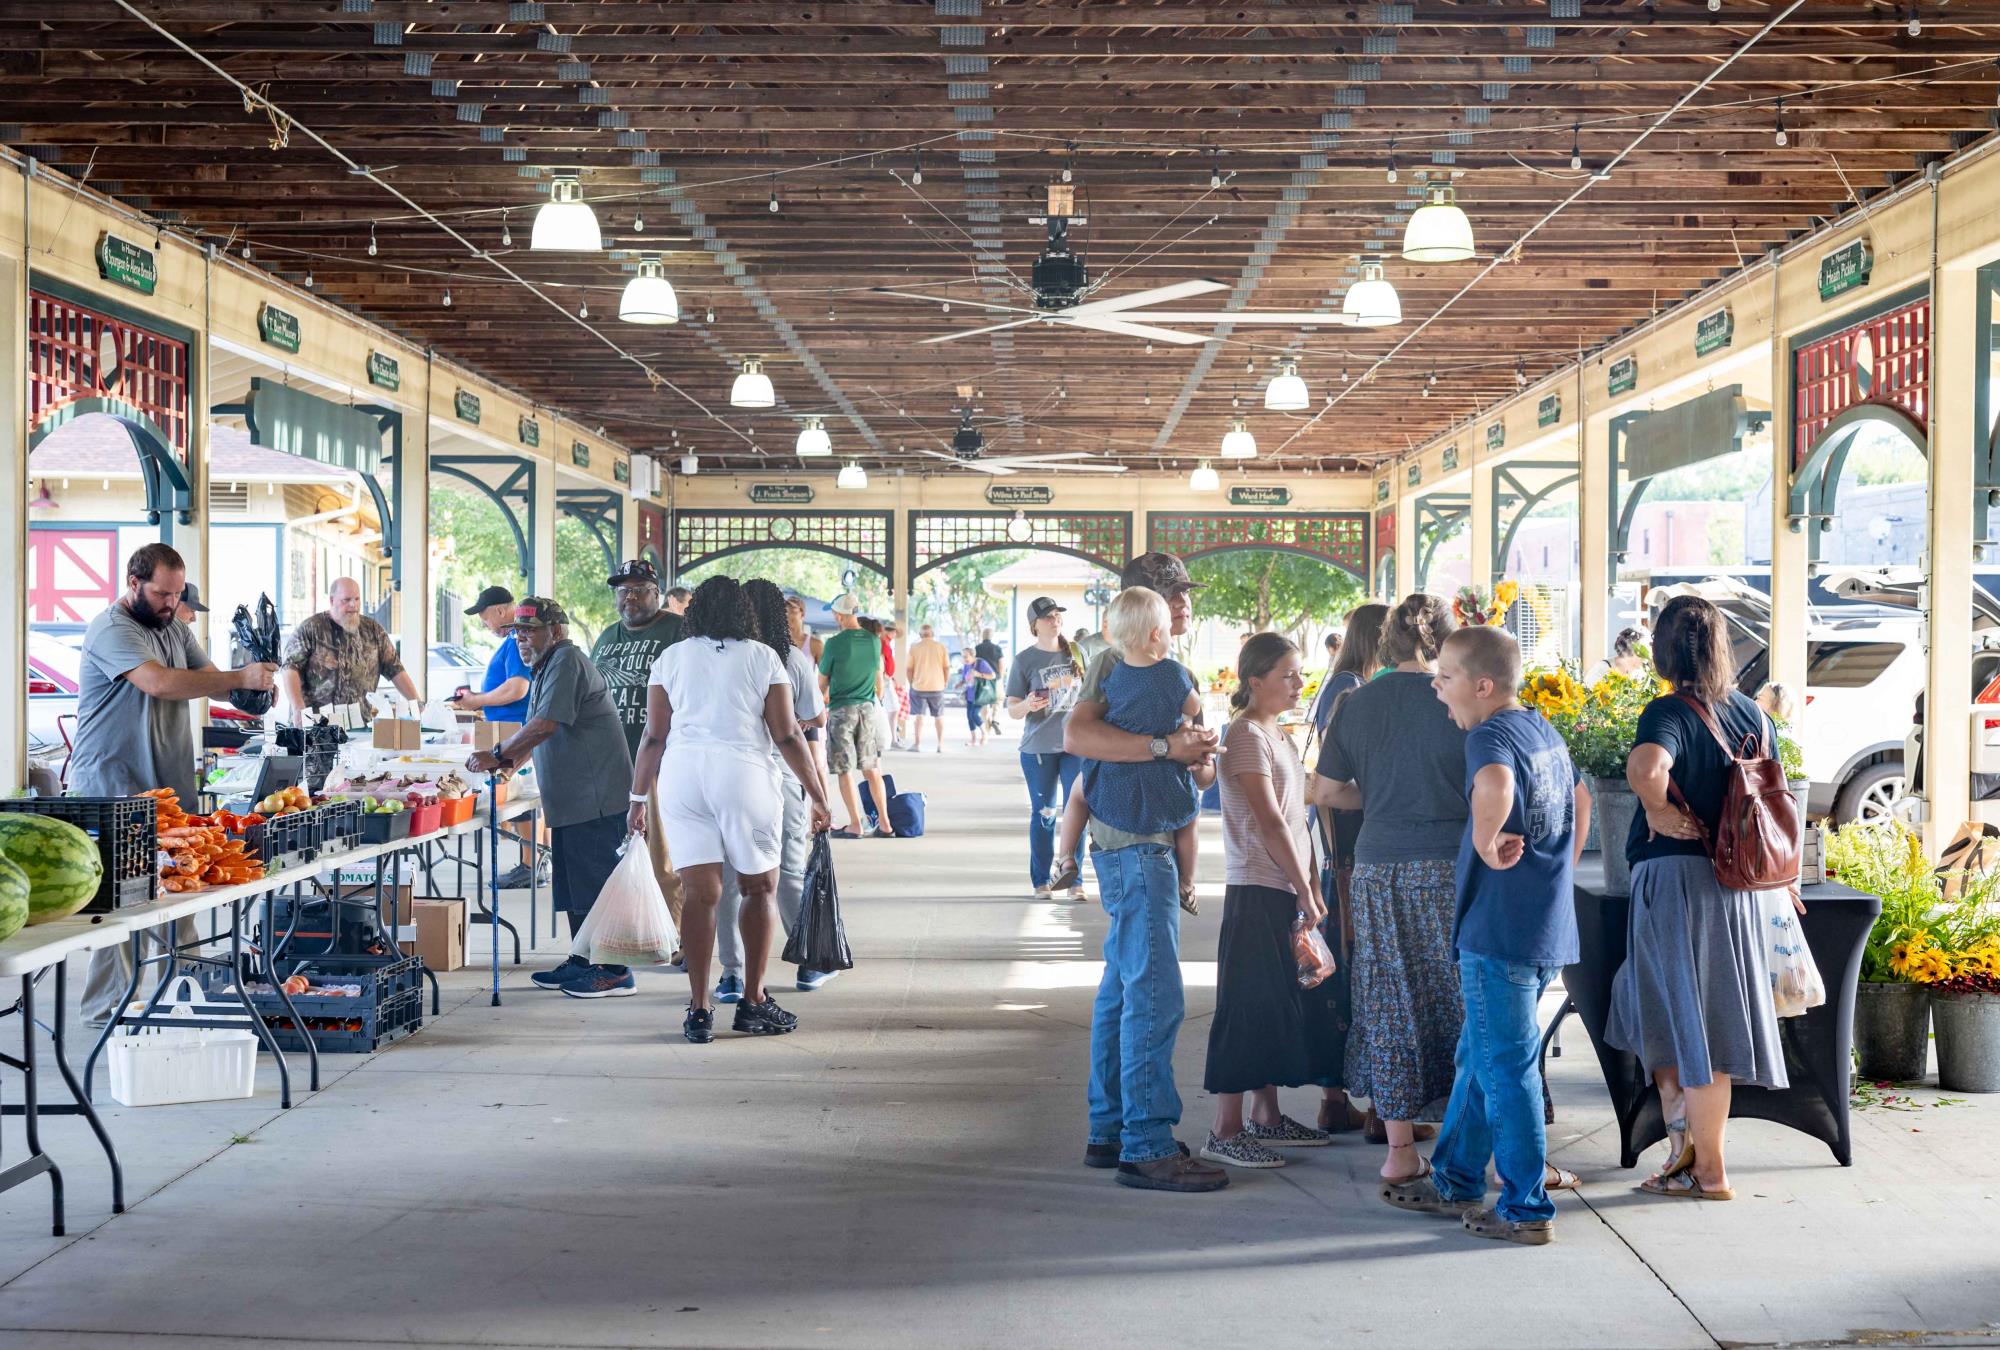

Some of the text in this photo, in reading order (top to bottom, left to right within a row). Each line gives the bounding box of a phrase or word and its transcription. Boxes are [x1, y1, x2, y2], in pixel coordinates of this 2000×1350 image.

[1826, 259, 1856, 286] Heath Pickler
[596, 639, 661, 659] SUPPORT
[619, 654, 655, 671] YOUR
[328, 873, 394, 883] TOMATOS
